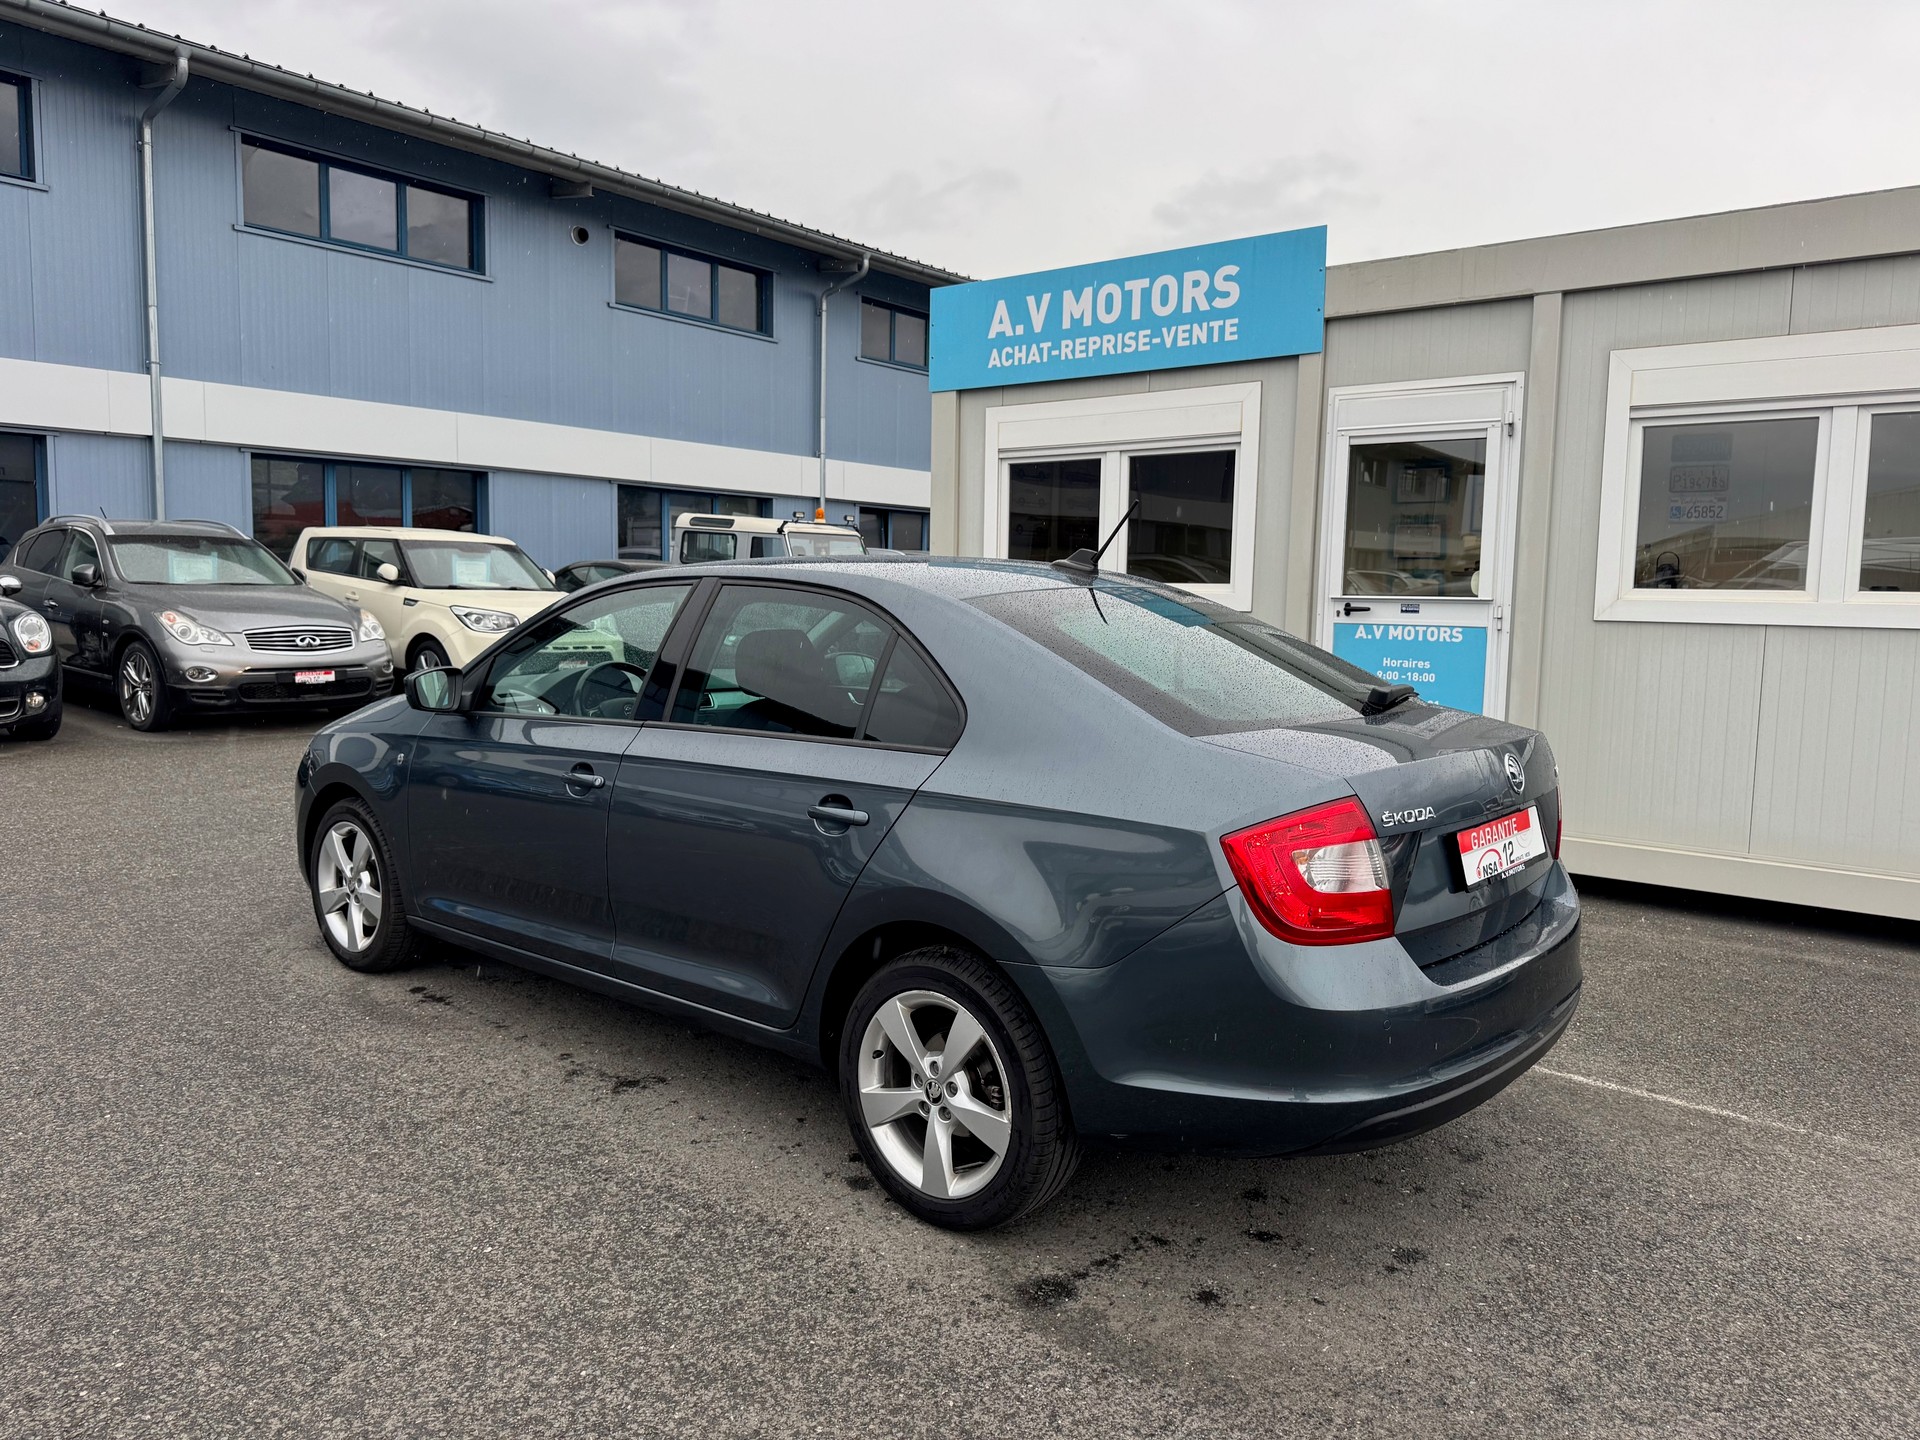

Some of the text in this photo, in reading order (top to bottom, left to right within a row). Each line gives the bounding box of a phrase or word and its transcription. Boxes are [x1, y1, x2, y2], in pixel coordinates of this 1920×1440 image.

[987, 265, 1240, 339] A.V MOTORS
[987, 318, 1239, 369] ACHAT-REPRISE-VENTE
[1686, 505, 1723, 519] 65852
[1355, 625, 1463, 642] A.V MOTORS
[1383, 657, 1430, 669] Horaires
[1377, 671, 1399, 681] 9:00
[1381, 806, 1436, 828] ŠKODA
[1471, 817, 1518, 849] GARANTIE
[1482, 861, 1499, 878] NSA
[1502, 840, 1515, 866] 12
